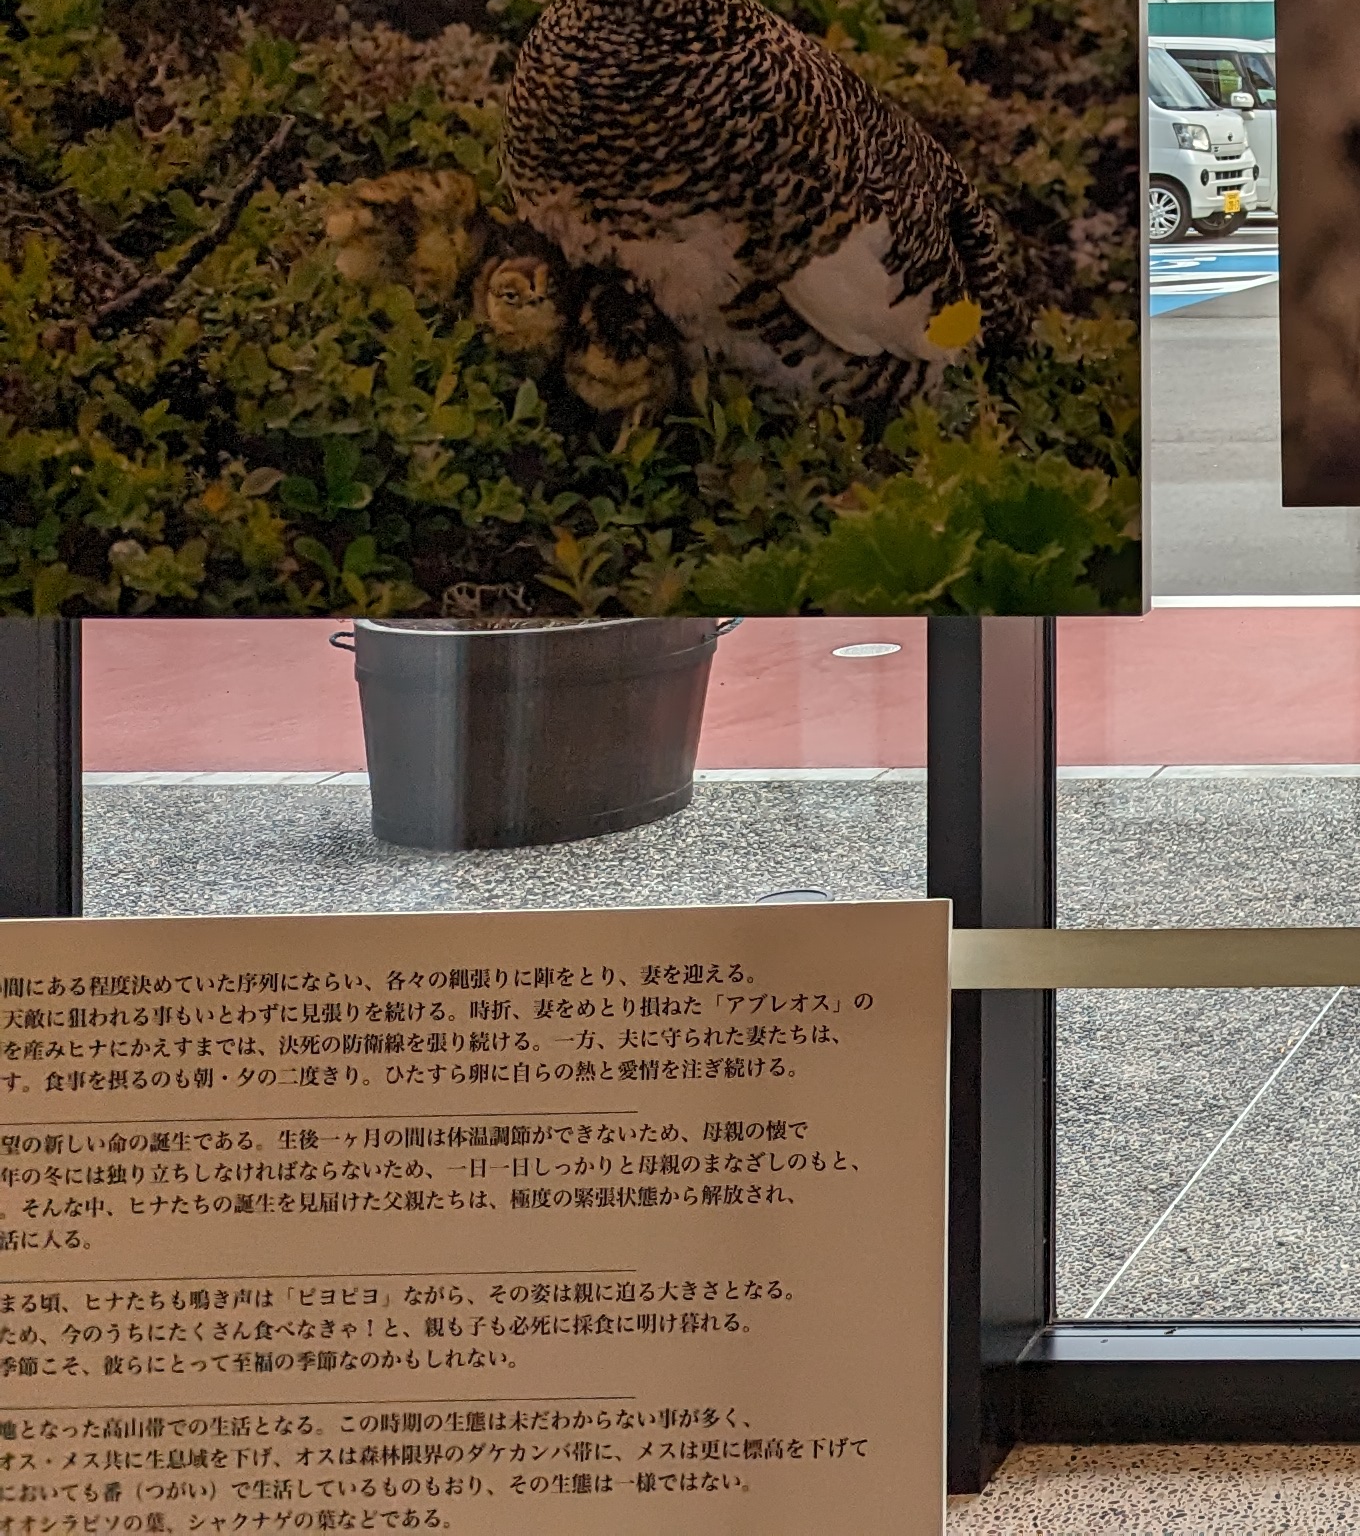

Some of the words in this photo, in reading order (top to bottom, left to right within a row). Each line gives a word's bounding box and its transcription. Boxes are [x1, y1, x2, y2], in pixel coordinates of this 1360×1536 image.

[0, 963, 757, 998] 間にある程度決めていた序列にならい、各々の縄張りに陣をとり、妻を迎える。
